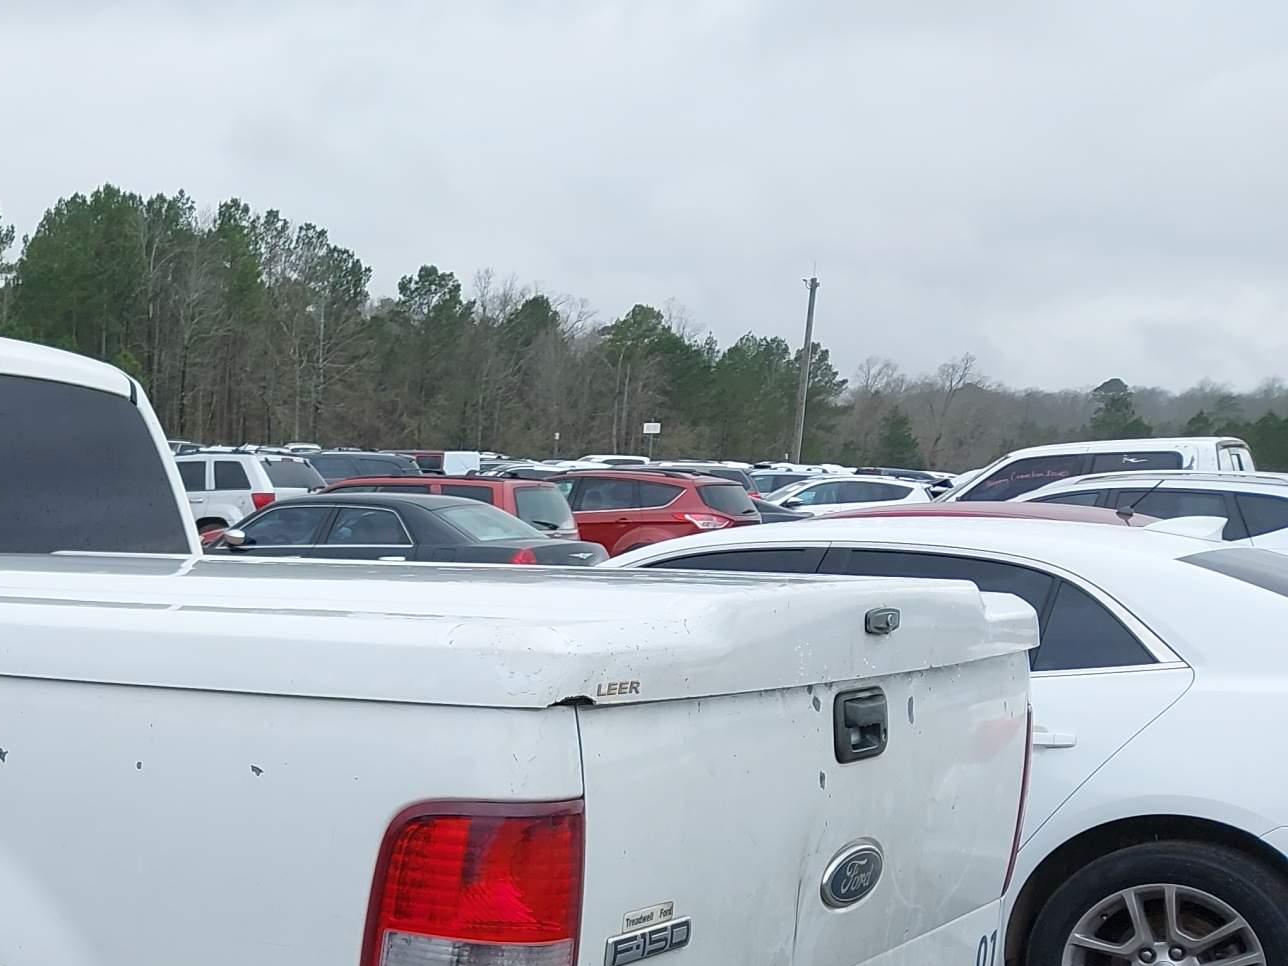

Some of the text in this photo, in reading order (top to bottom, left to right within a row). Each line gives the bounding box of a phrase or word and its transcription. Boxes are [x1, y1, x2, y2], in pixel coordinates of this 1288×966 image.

[596, 680, 641, 697] LEER
[840, 858, 874, 894] Ford
[625, 907, 673, 928] Treadwell Ford
